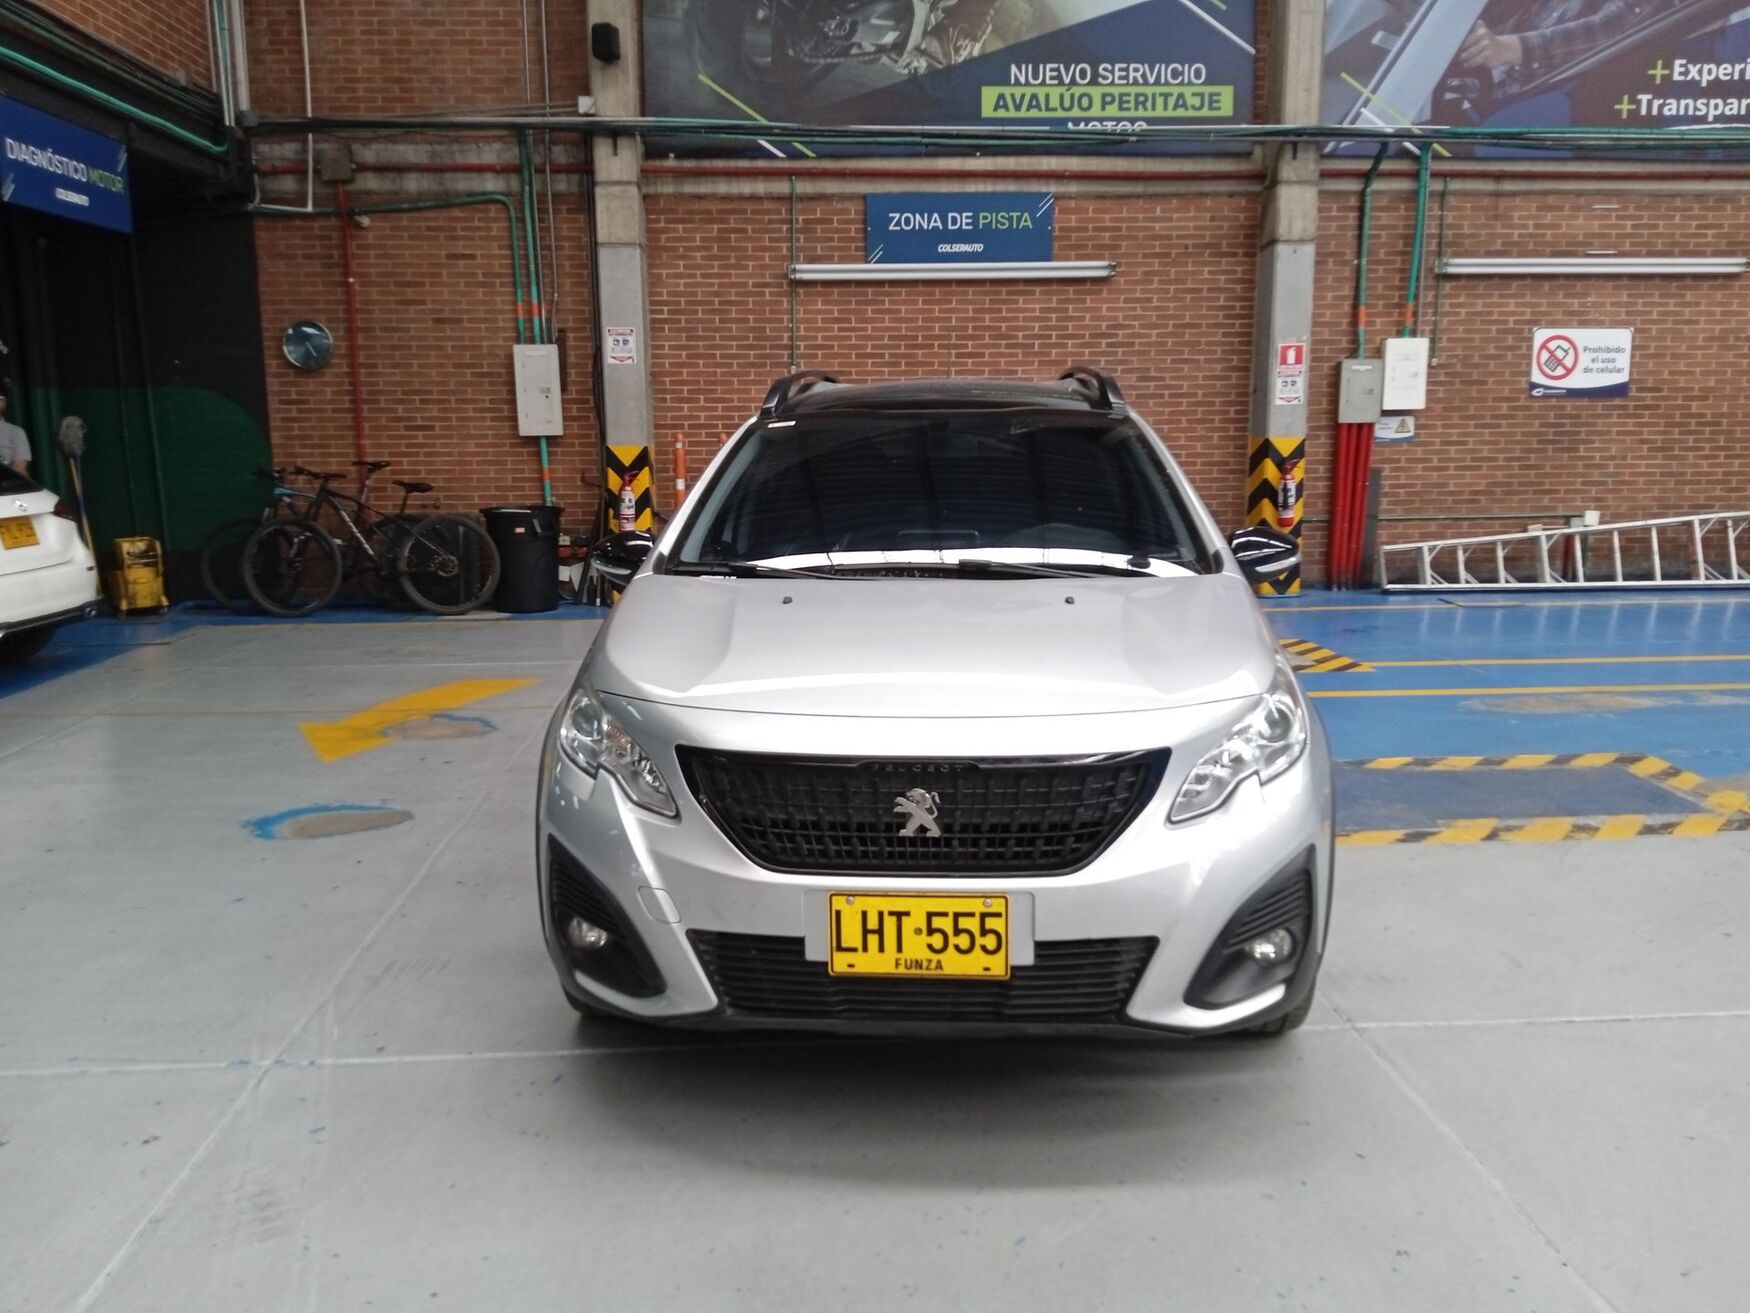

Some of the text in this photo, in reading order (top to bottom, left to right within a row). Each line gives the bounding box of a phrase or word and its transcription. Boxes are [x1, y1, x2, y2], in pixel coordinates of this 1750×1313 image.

[1010, 63, 1206, 85] NUEVO SERVICIO
[992, 87, 1222, 112] AVALÚO PERITAJE
[5, 137, 88, 182] DIAGNÓSTICO
[888, 211, 1033, 230] ZONA DE PISTA
[1583, 345, 1626, 354] Prohibido
[1591, 355, 1617, 364] el uso
[1583, 365, 1625, 374] de celular
[834, 909, 1003, 955] LHT 555
[895, 958, 944, 971] FUNZA
